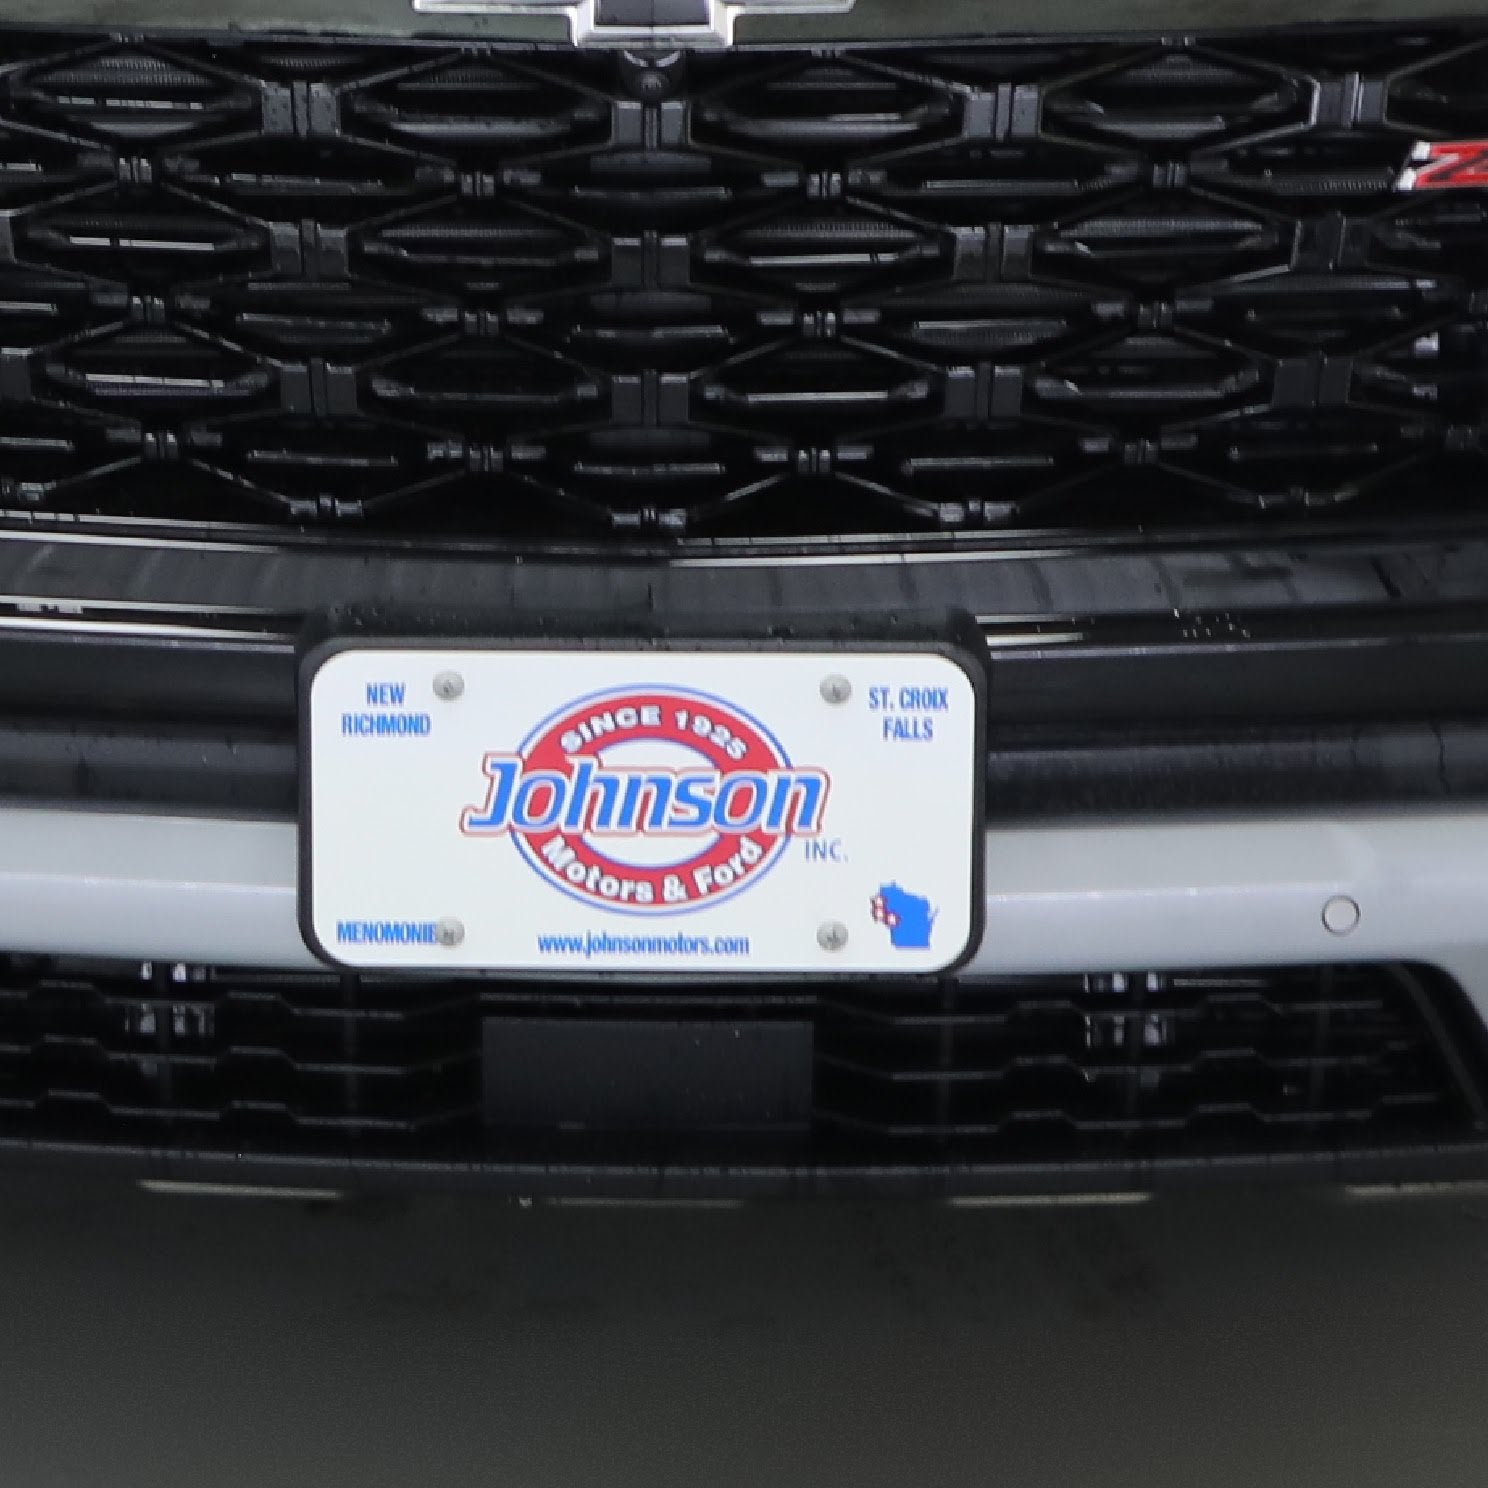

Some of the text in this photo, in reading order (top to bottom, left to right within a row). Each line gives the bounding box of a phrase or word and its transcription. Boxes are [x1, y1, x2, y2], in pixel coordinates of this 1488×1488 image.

[366, 682, 406, 706] NEW
[868, 686, 949, 710] ST. CROIX
[341, 713, 432, 737] RICHMOND
[560, 705, 662, 754] SINCE
[882, 716, 933, 741] FALLS
[460, 752, 830, 836] Johnson
[540, 834, 764, 903] Motors & Ford
[336, 920, 439, 945] MENOMONIE
[537, 929, 751, 959] www.johnsonmotors.com
